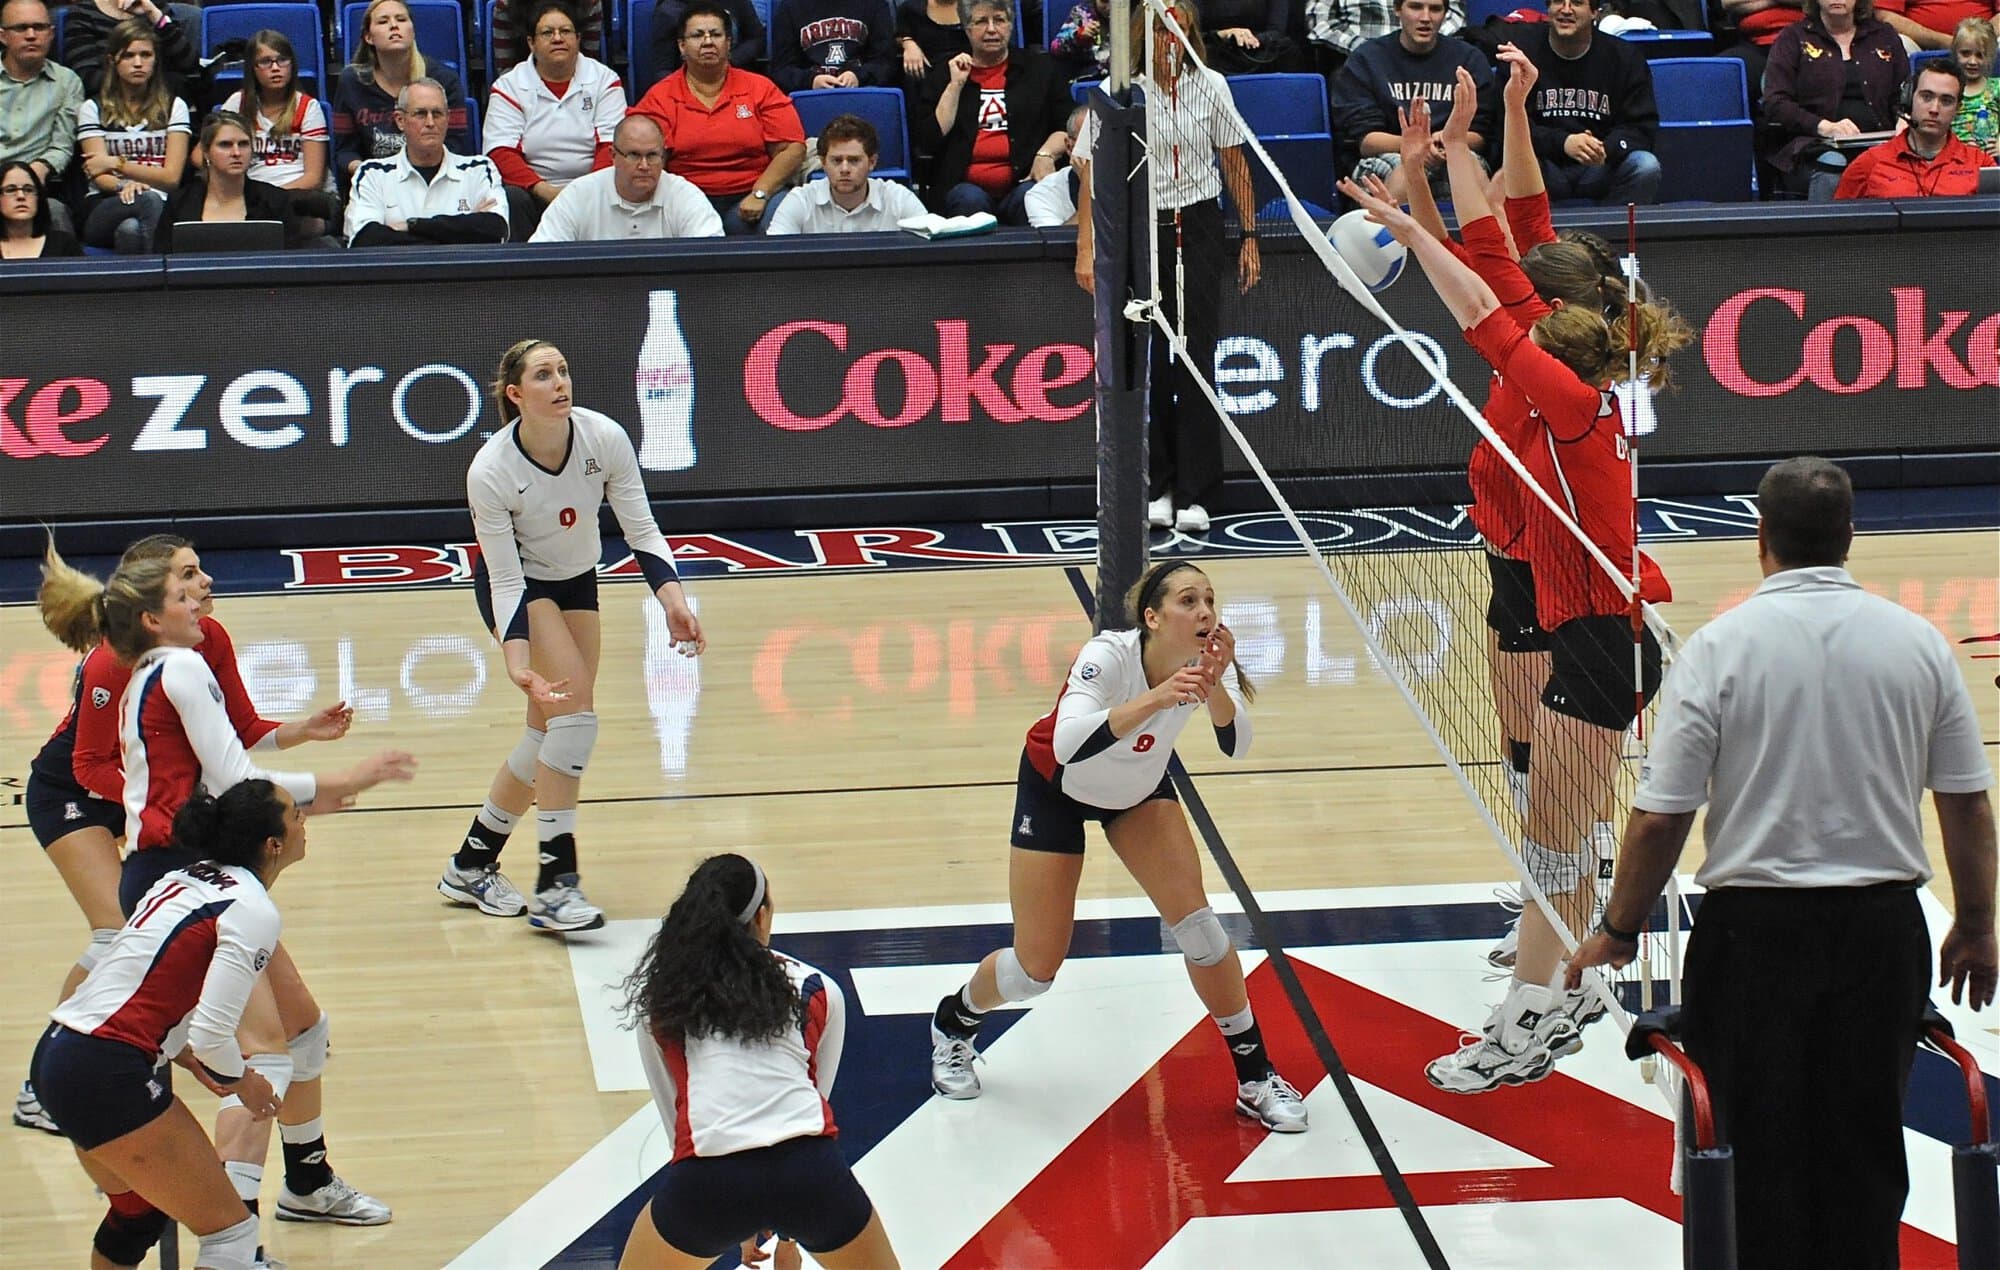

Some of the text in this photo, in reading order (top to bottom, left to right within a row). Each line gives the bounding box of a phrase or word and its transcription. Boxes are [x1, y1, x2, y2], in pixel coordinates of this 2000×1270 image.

[1537, 88, 1611, 115] ARIZONA
[1543, 110, 1601, 121] WILDCATS
[743, 319, 1095, 432] Coke
